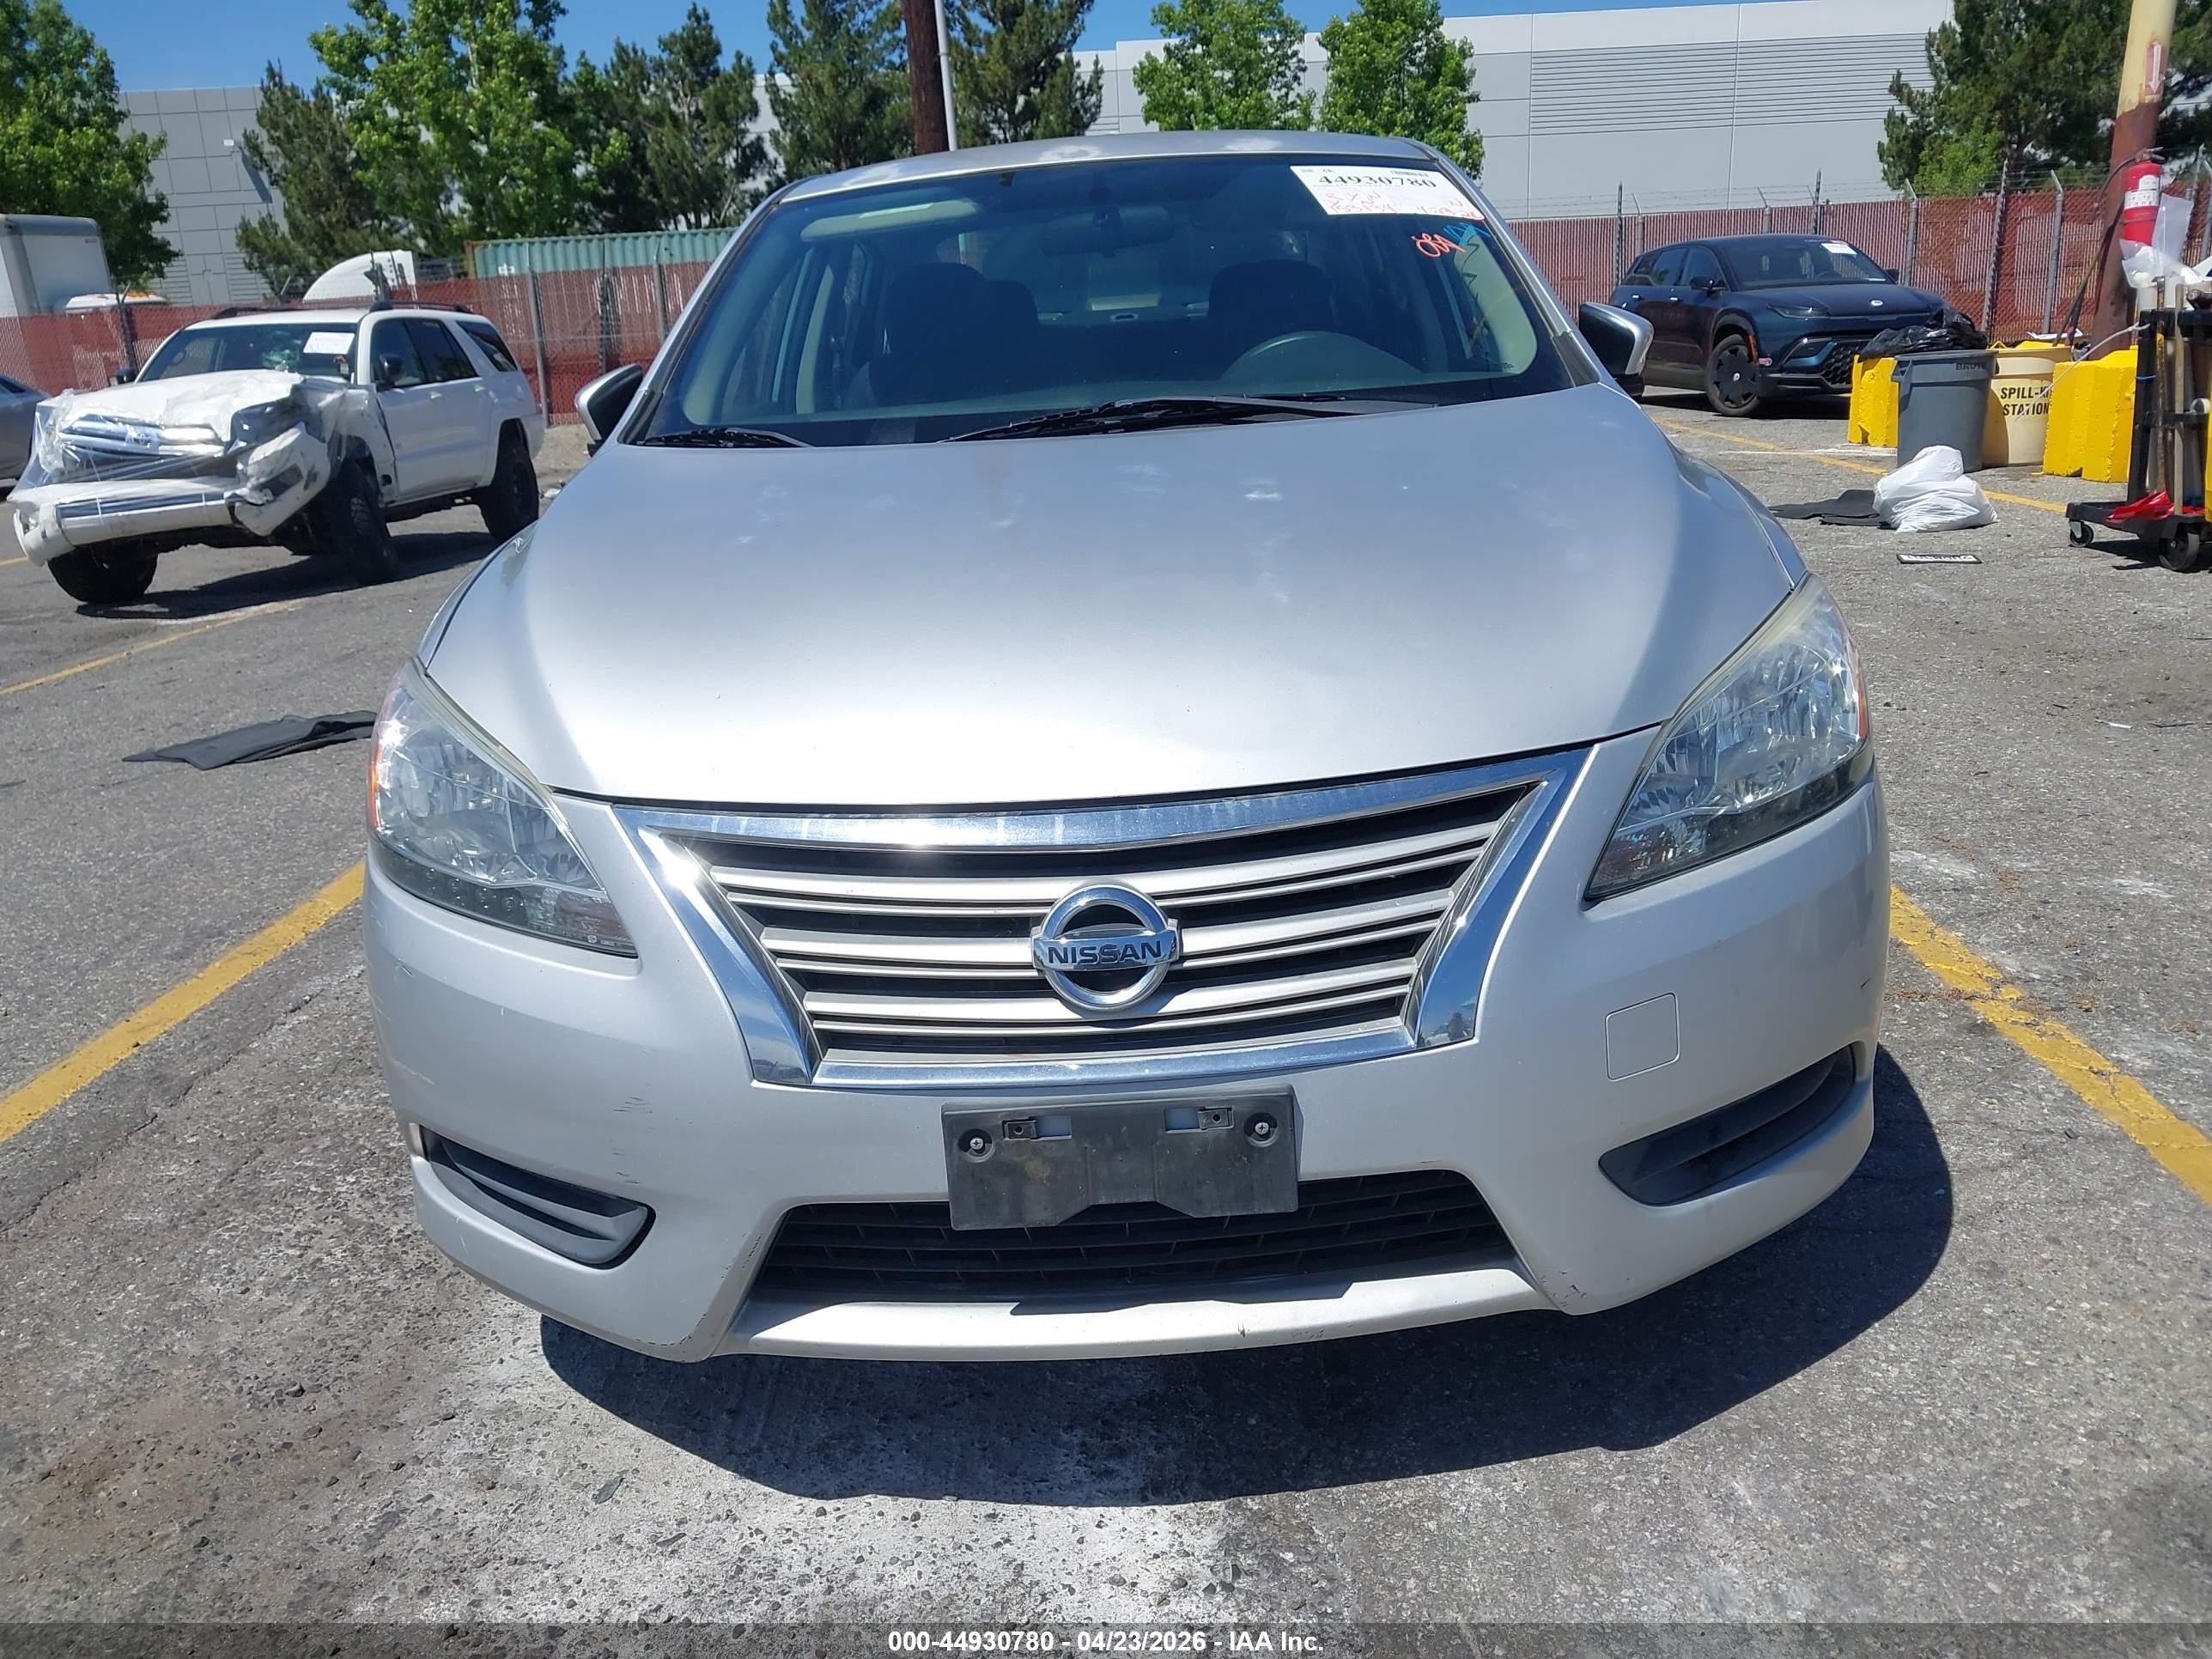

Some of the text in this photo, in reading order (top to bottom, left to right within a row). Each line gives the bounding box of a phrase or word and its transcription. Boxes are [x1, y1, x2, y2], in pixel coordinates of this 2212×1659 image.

[1319, 175, 1437, 187] 44930780
[2001, 385, 2052, 399] SPILL-KI
[2002, 403, 2050, 416] STATION
[1047, 939, 1162, 964] NISSAN
